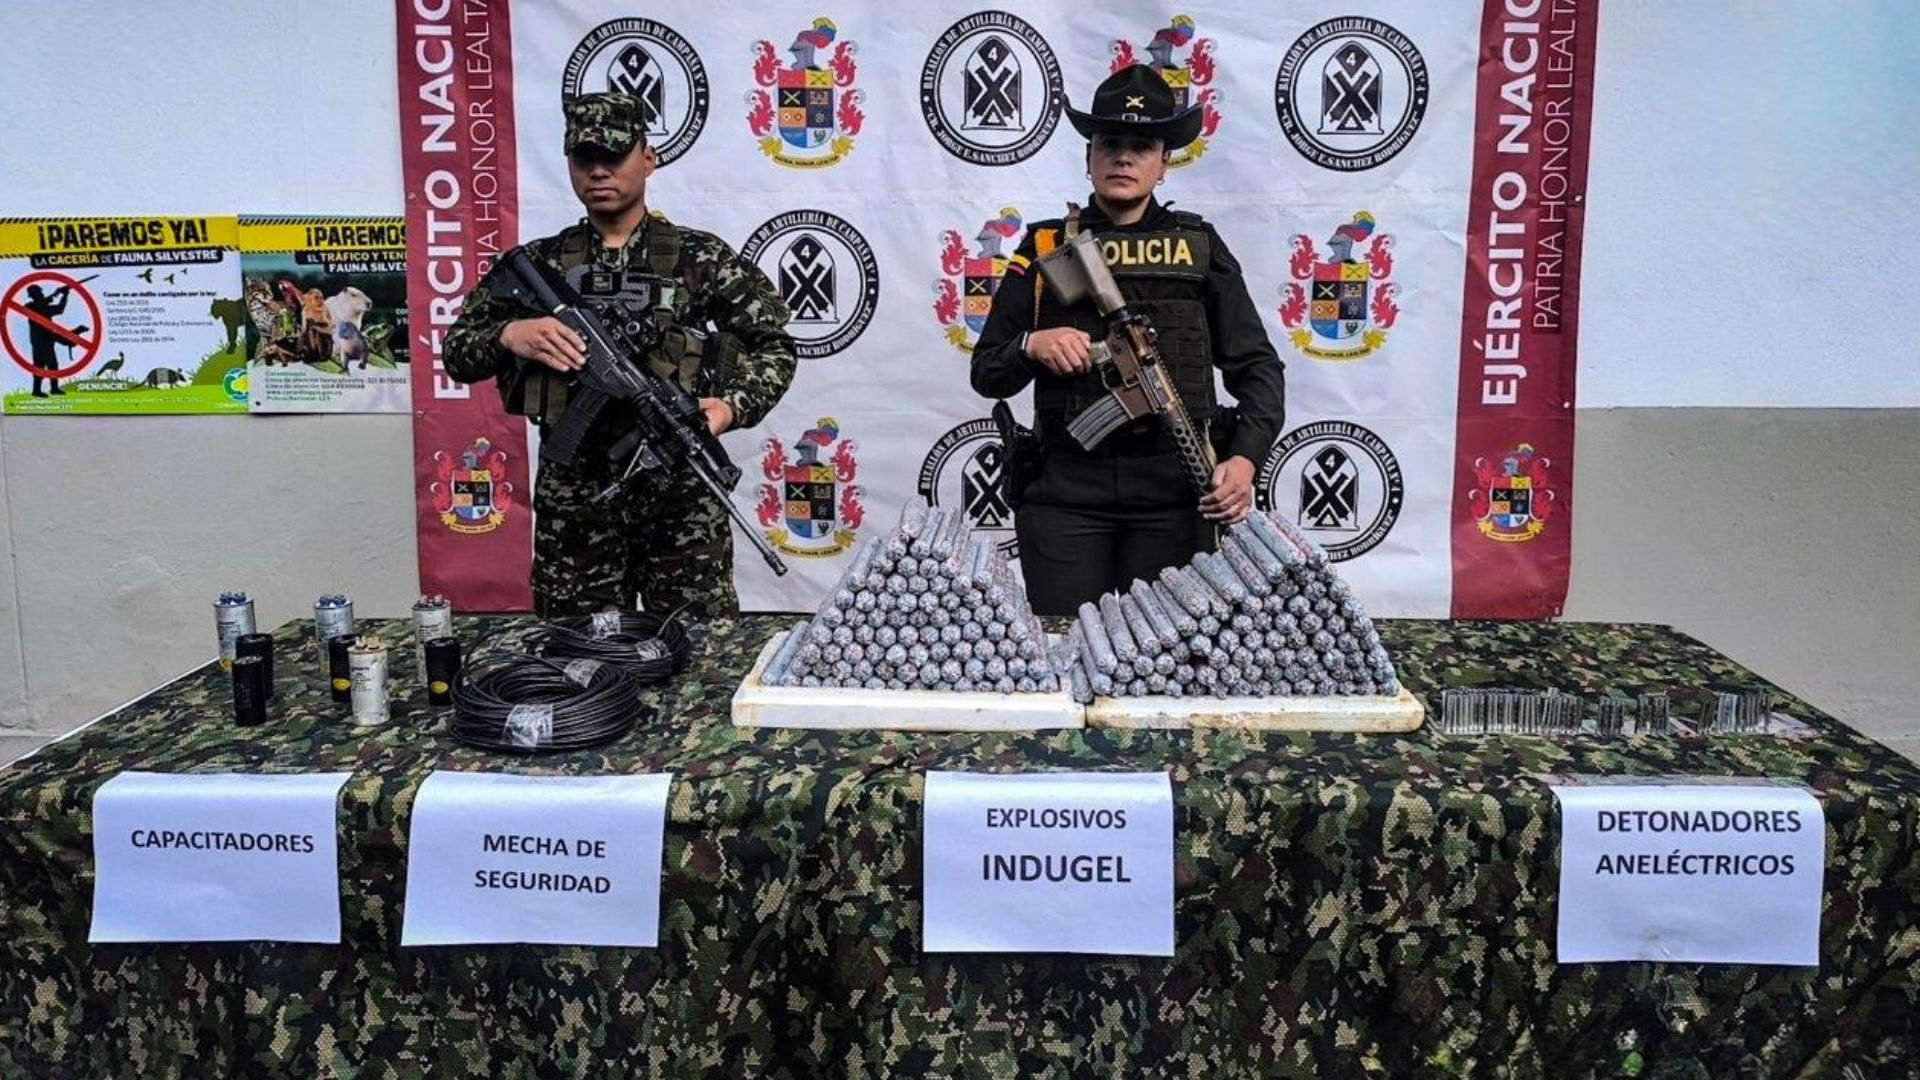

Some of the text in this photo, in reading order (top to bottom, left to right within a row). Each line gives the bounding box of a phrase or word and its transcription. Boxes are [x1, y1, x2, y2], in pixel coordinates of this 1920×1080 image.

[585, 35, 599, 50] DE
[652, 22, 665, 39] DE
[944, 29, 959, 42] DE
[1013, 21, 1026, 35] DE
[1301, 33, 1317, 47] DE
[1373, 22, 1386, 37] DE
[463, 0, 493, 90] LEALT
[987, 47, 999, 62] 4
[628, 54, 639, 68] 4
[1345, 52, 1356, 67] 4
[1291, 130, 1320, 159] JORGE
[469, 98, 499, 221] HONOR
[1533, 0, 1577, 329] PATRIA HONOR LEALT
[37, 218, 209, 250] ¡PAREMOS YA!
[758, 226, 772, 240] DE
[825, 216, 838, 230] DE
[34, 258, 48, 267] LA
[48, 253, 99, 265] CACERÍA
[114, 252, 154, 264] FAUNA
[155, 249, 219, 263] SILVESTRE
[307, 254, 319, 263] EL
[371, 252, 380, 261] Y
[800, 244, 811, 258] 4
[1102, 237, 1194, 266] OLICIA
[329, 263, 369, 273] FAUNA
[1473, 170, 1527, 405] EJÉRCITO
[942, 432, 956, 447] DE
[1282, 435, 1298, 449] DE
[1352, 425, 1366, 442] DE
[983, 453, 995, 466] 4
[1324, 454, 1336, 469] 4
[986, 808, 1127, 830] EXPLOSIVOS
[1598, 810, 1802, 833] DETONADORES
[130, 829, 315, 854] CAPACITADORES
[483, 833, 606, 859] MECHA DE
[983, 854, 1132, 883] INDUGEL
[1595, 848, 1796, 876] ANELÉCTRICOS
[474, 869, 611, 894] SEGURIDAD
